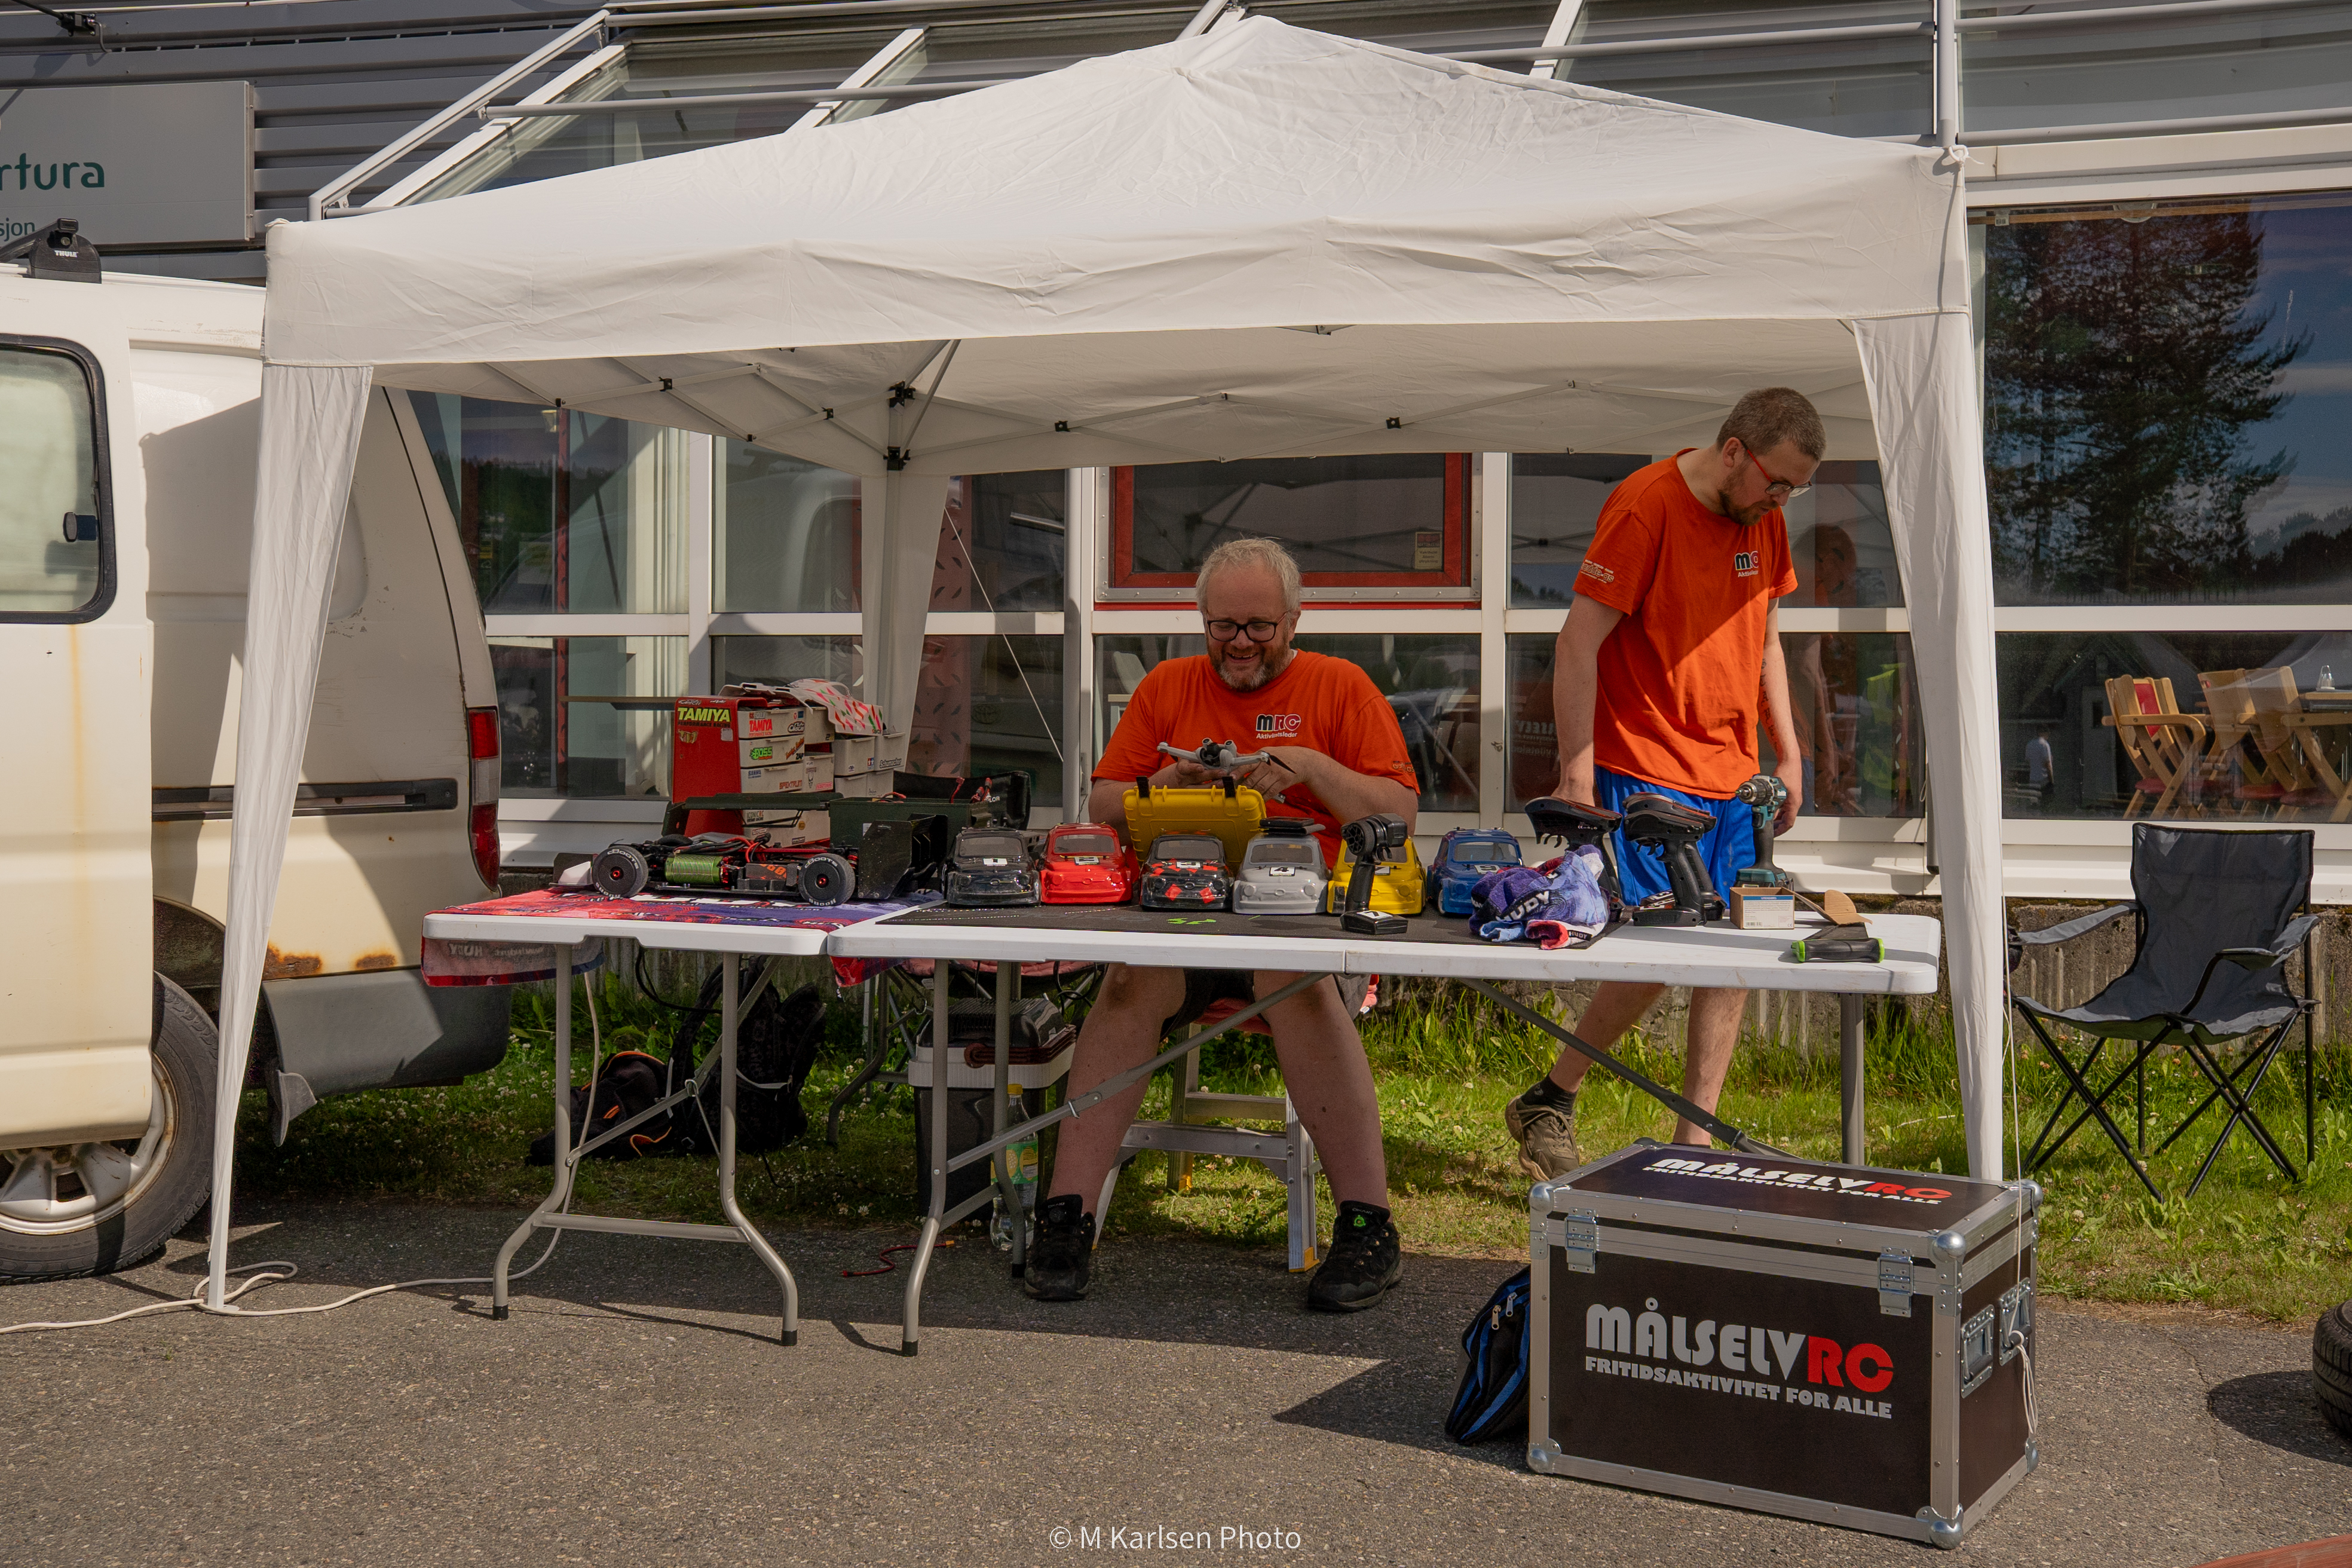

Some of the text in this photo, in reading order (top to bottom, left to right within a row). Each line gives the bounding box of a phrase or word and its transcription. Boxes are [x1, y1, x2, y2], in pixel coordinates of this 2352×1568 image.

[677, 707, 731, 722] TAMIYA
[749, 719, 773, 733] TAMIYA
[1569, 931, 1588, 939] HUDY
[1642, 1166, 1835, 1193] FRITIDSAKTIVITET
[1883, 1195, 1941, 1205] ALLE
[1585, 1356, 1892, 1419] FRITIDSAKTIVITET FOR ALLE
